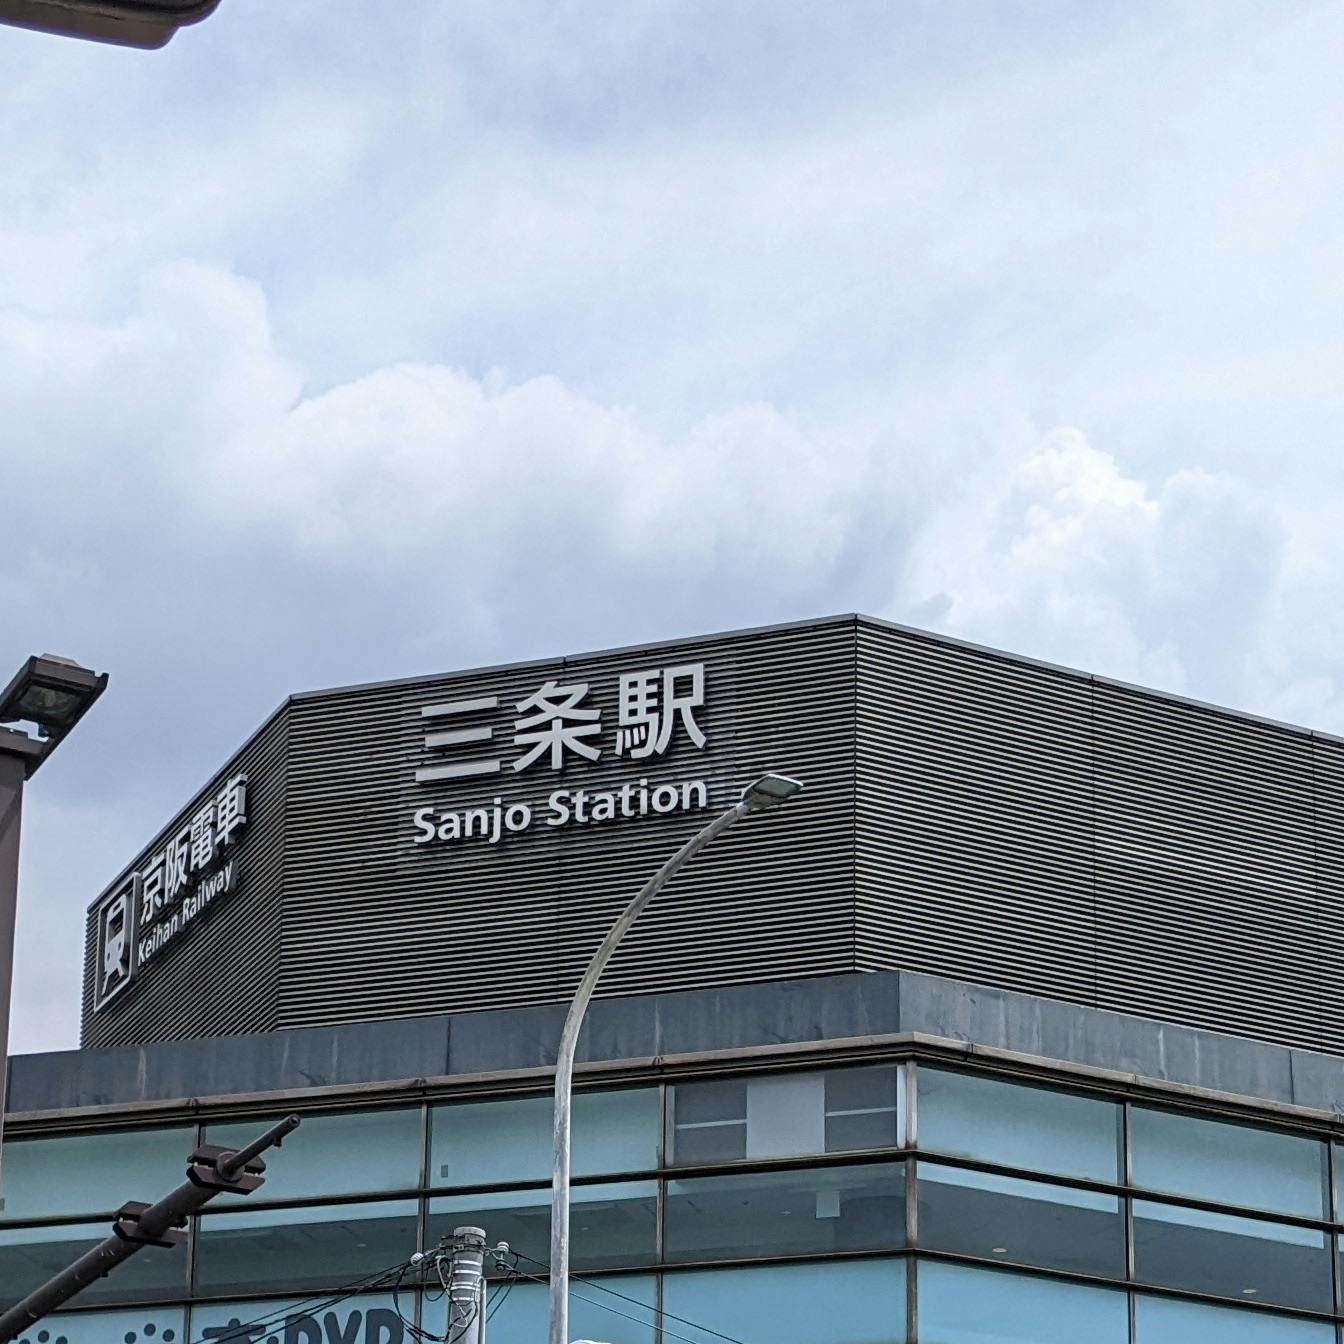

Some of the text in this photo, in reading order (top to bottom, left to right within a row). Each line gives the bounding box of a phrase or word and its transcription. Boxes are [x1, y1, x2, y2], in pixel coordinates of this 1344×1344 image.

[414, 662, 708, 784] 三条駅
[140, 774, 248, 926] 京阪電車
[413, 778, 709, 845] Sanjo Station
[137, 861, 234, 967] Keihan Railway
